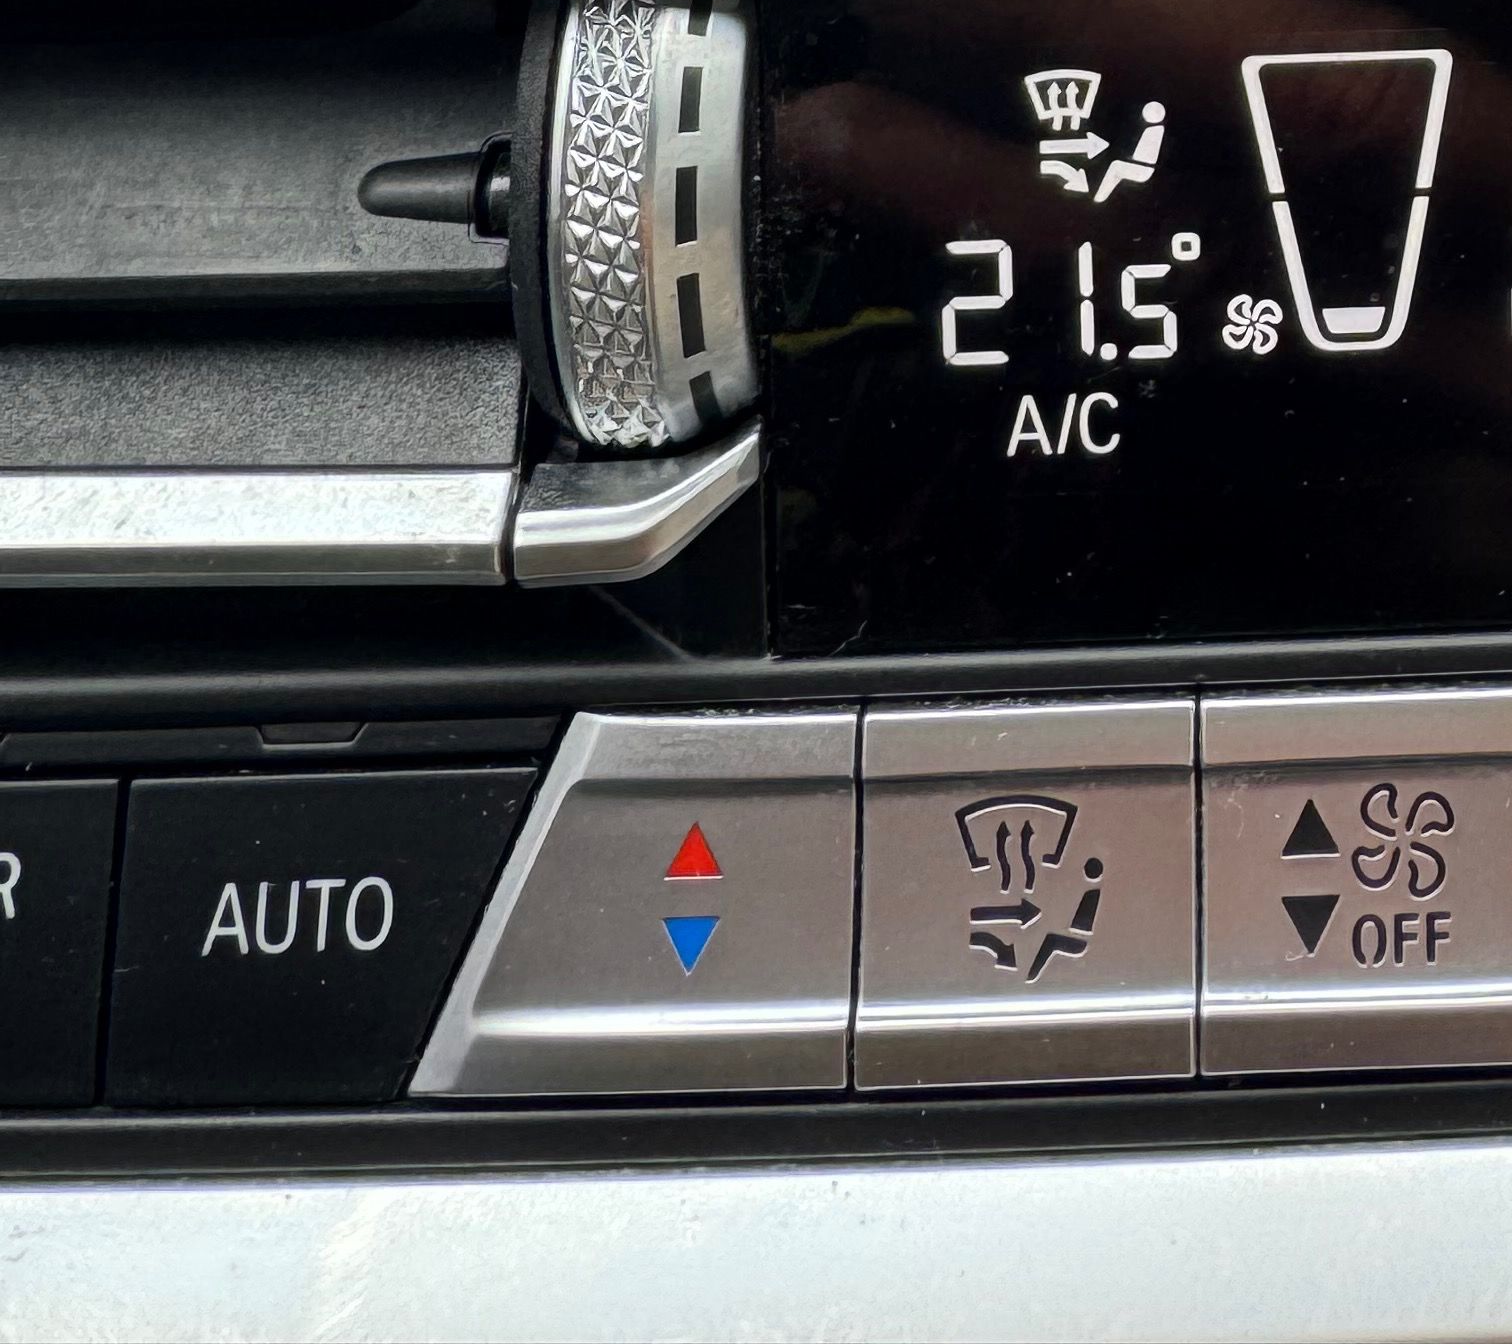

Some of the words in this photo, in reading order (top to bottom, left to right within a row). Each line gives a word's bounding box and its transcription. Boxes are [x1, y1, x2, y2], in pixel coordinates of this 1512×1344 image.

[1006, 391, 1121, 457] A/C
[201, 875, 395, 957] AUTO
[1351, 911, 1452, 969] OFF
